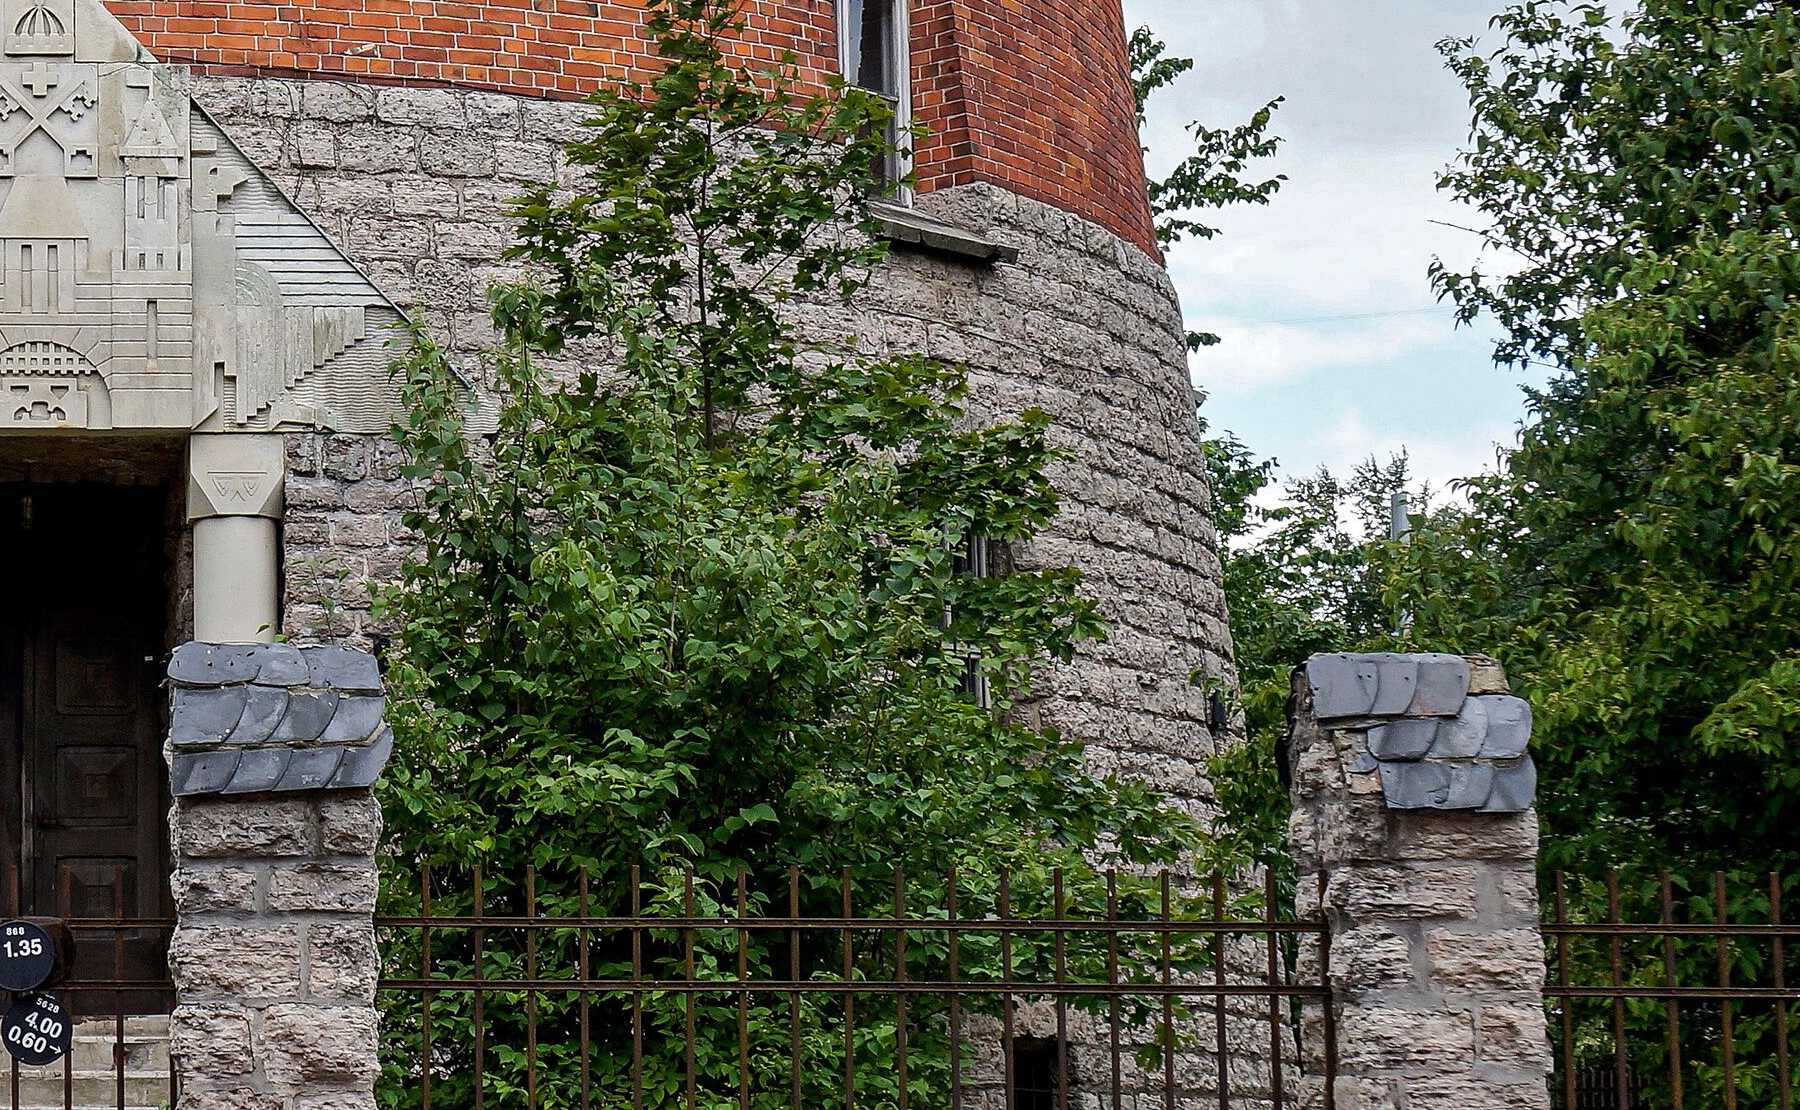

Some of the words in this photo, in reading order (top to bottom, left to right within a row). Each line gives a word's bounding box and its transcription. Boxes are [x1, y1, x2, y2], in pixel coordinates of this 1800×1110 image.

[6, 926, 25, 936] 868
[3, 938, 43, 958] 1.35
[36, 997, 60, 1014] 5628
[25, 1011, 63, 1038] 4.00
[8, 1025, 47, 1053] 0.60
